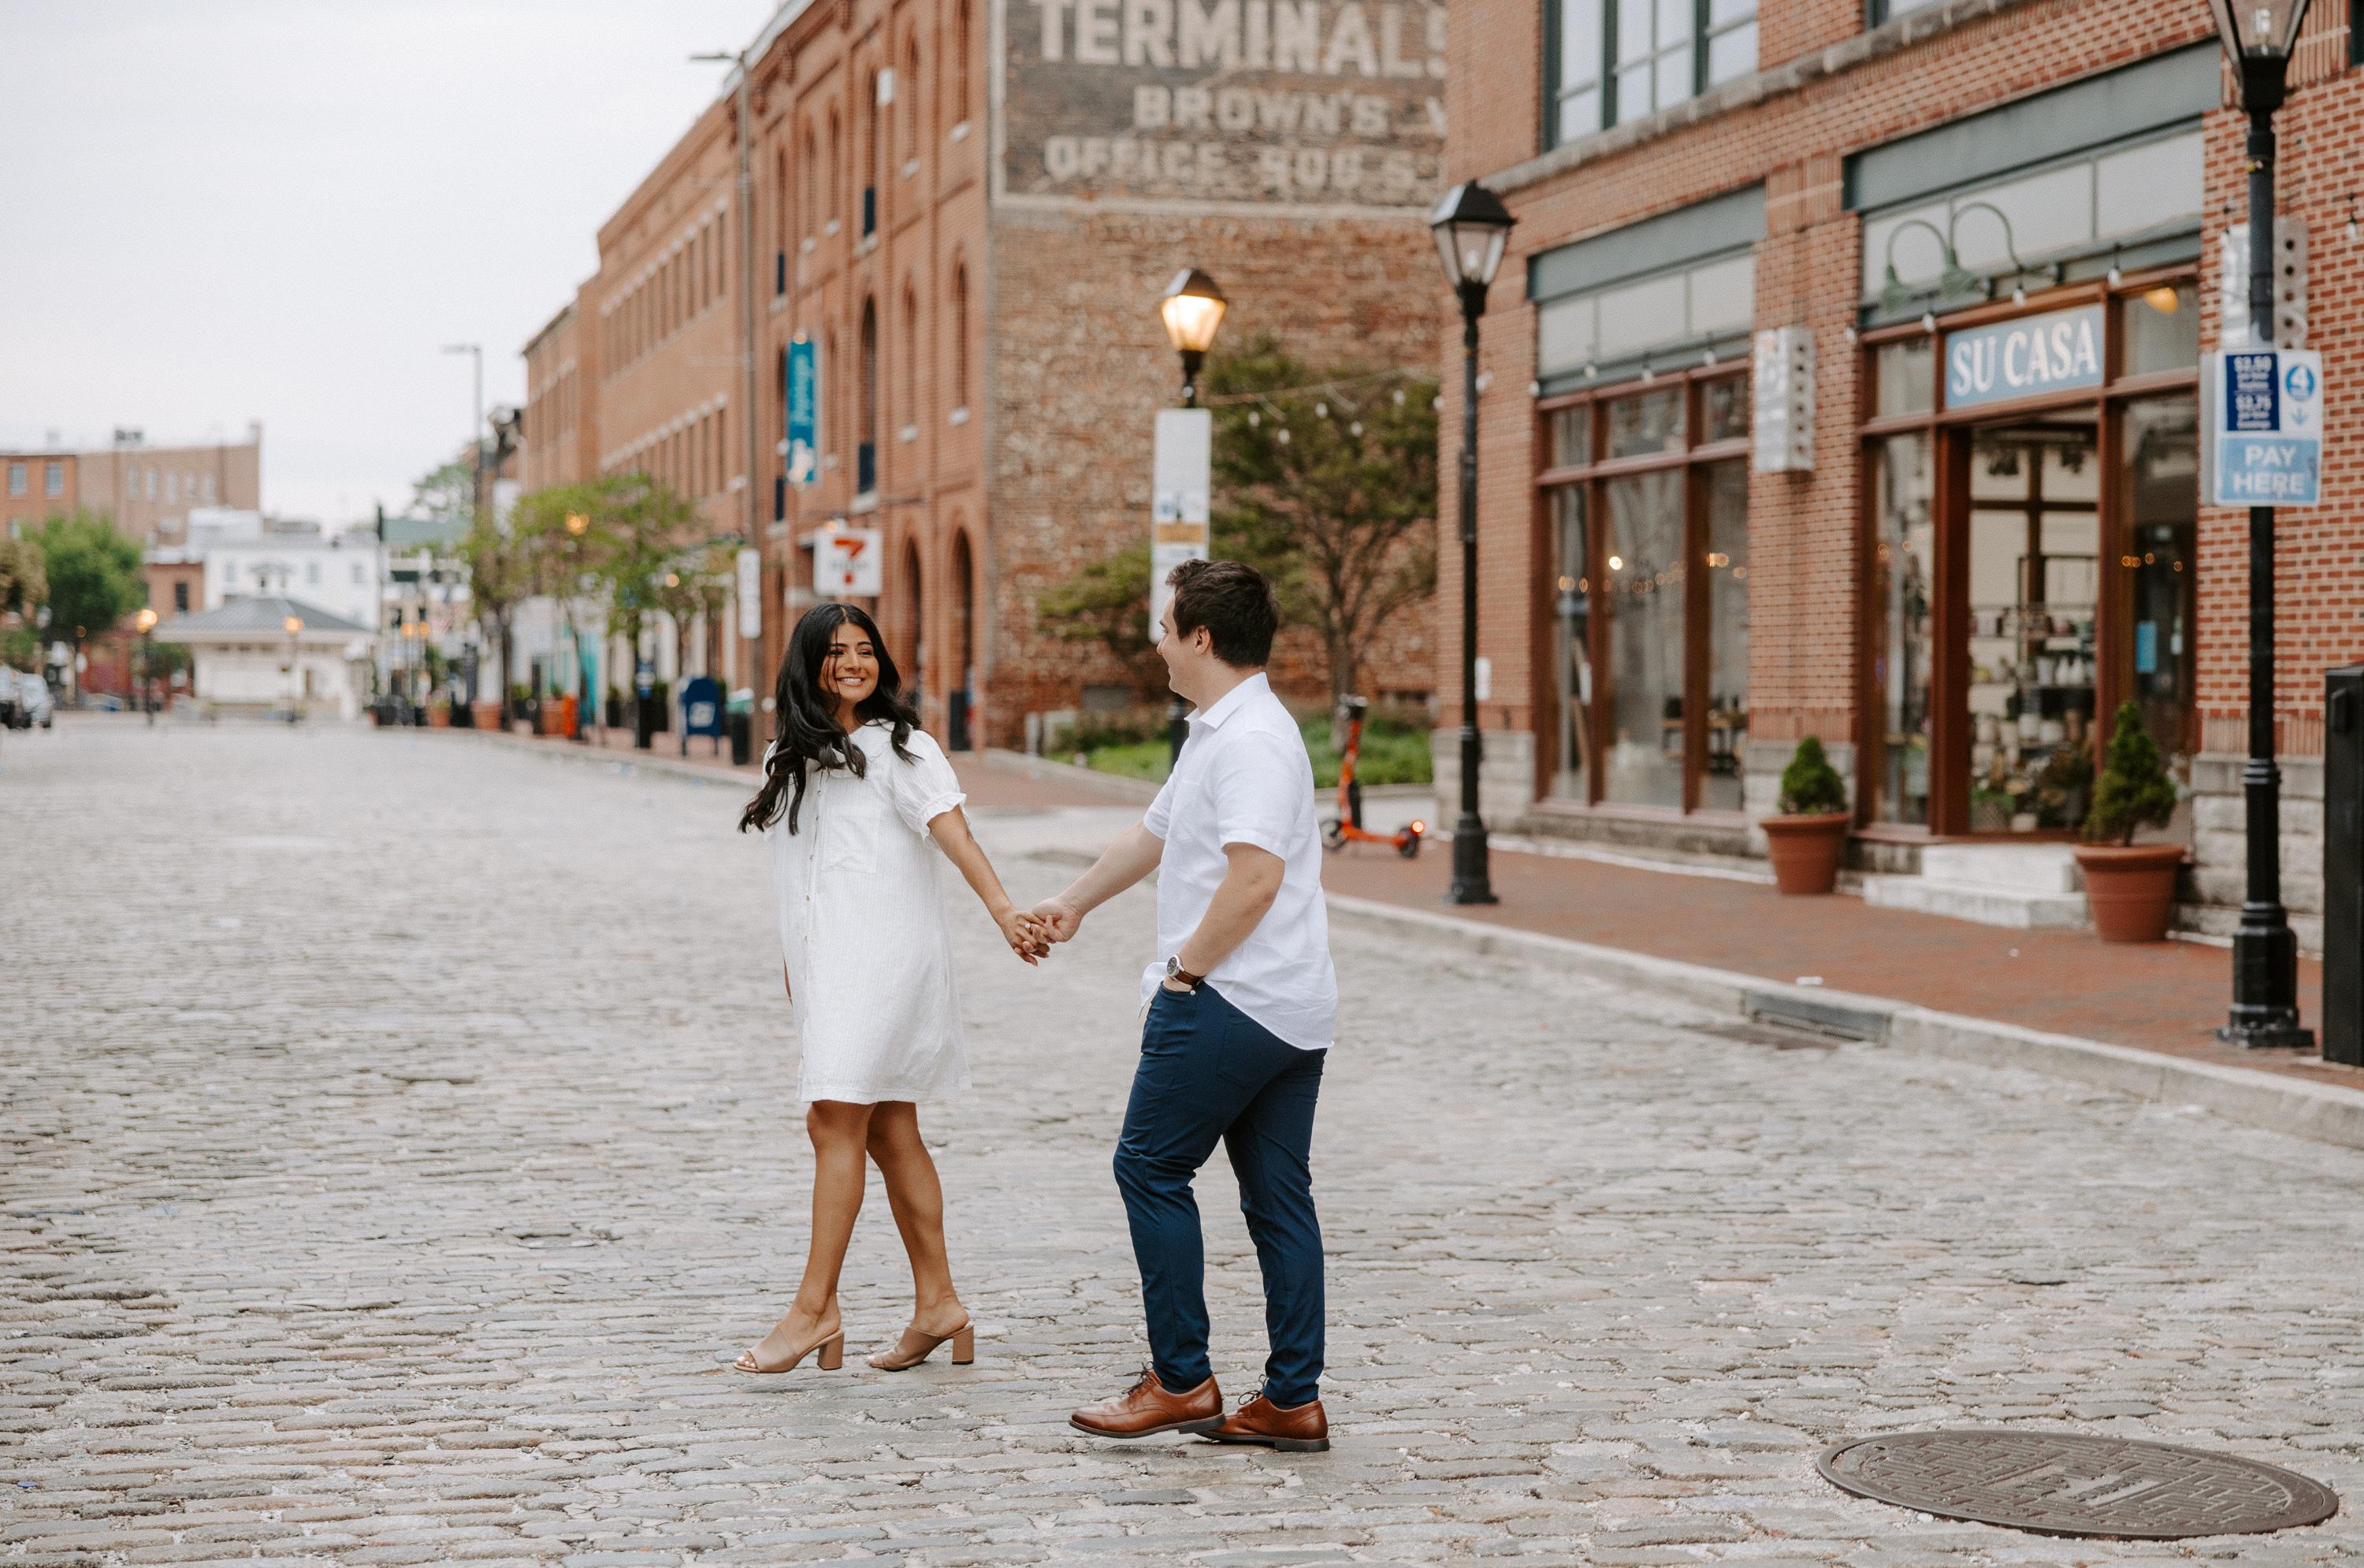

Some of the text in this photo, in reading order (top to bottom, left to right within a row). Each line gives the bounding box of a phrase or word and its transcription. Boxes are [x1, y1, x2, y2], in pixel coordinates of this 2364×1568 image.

[1133, 84, 1391, 137] BROWN'S
[1952, 318, 2098, 396] SU CASA
[2246, 444, 2296, 467] PAY
[2232, 472, 2304, 499] HERE
